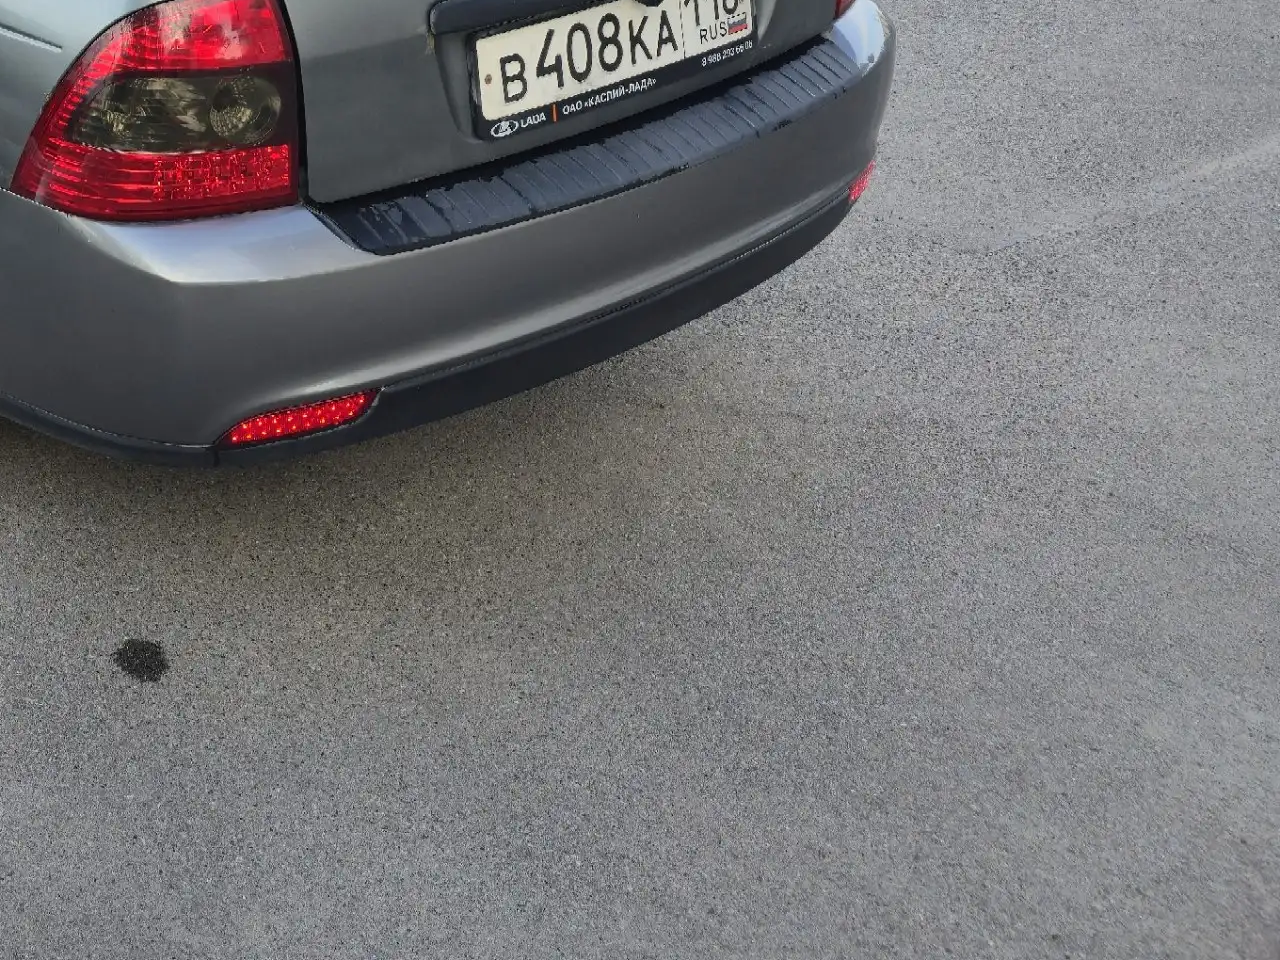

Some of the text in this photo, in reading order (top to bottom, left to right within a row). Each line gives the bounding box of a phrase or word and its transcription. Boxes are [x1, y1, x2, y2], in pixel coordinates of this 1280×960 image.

[699, 21, 727, 44] RUS
[562, 78, 658, 115] ОАО «КАСПИЙ-ЛАДА»
[520, 112, 547, 128] LADA
